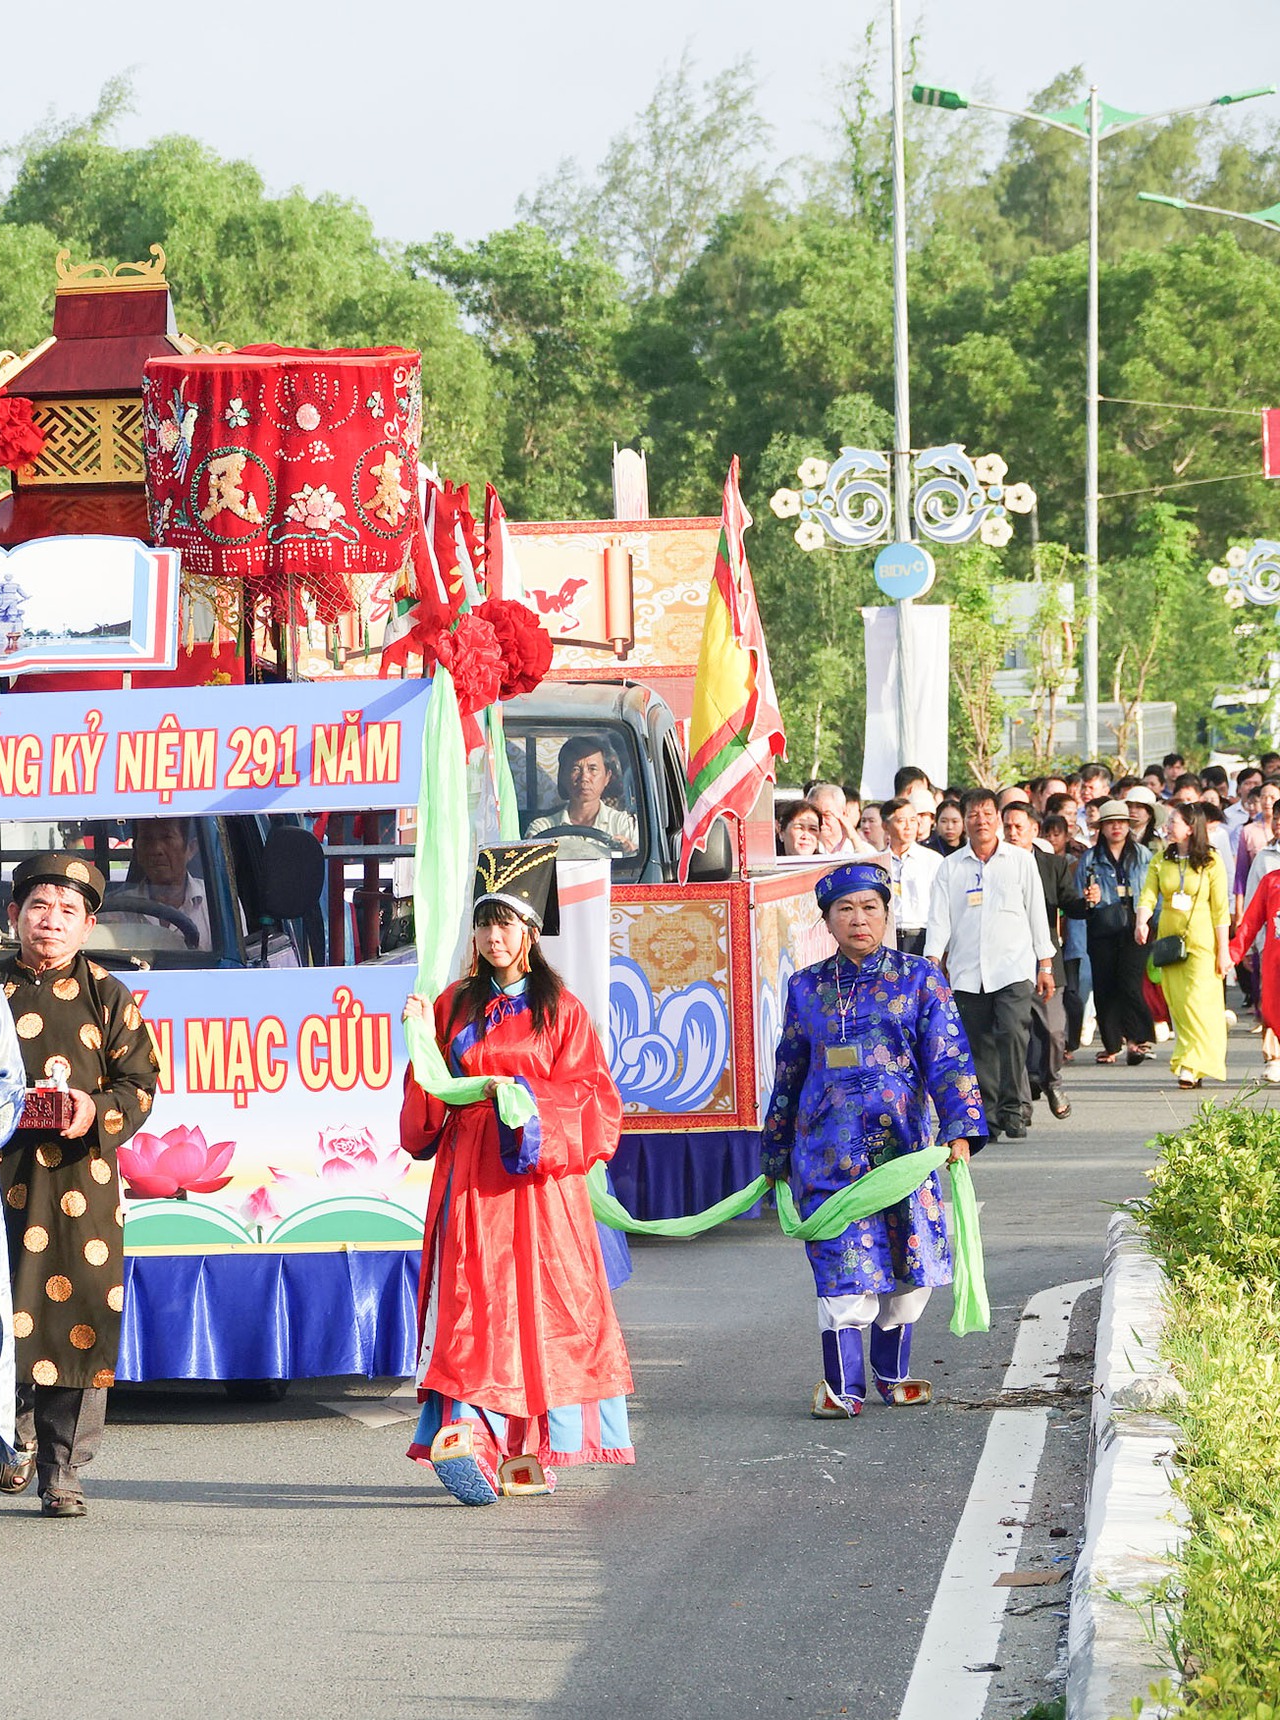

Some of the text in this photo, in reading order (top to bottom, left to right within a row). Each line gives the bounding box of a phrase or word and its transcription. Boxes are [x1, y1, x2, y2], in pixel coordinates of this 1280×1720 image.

[50, 709, 107, 796] KỶ
[115, 713, 218, 805] NIỆM
[225, 725, 300, 789] 291
[310, 709, 401, 785] NĂM
[185, 1017, 288, 1108] MẠC
[296, 984, 391, 1092] CỬU
